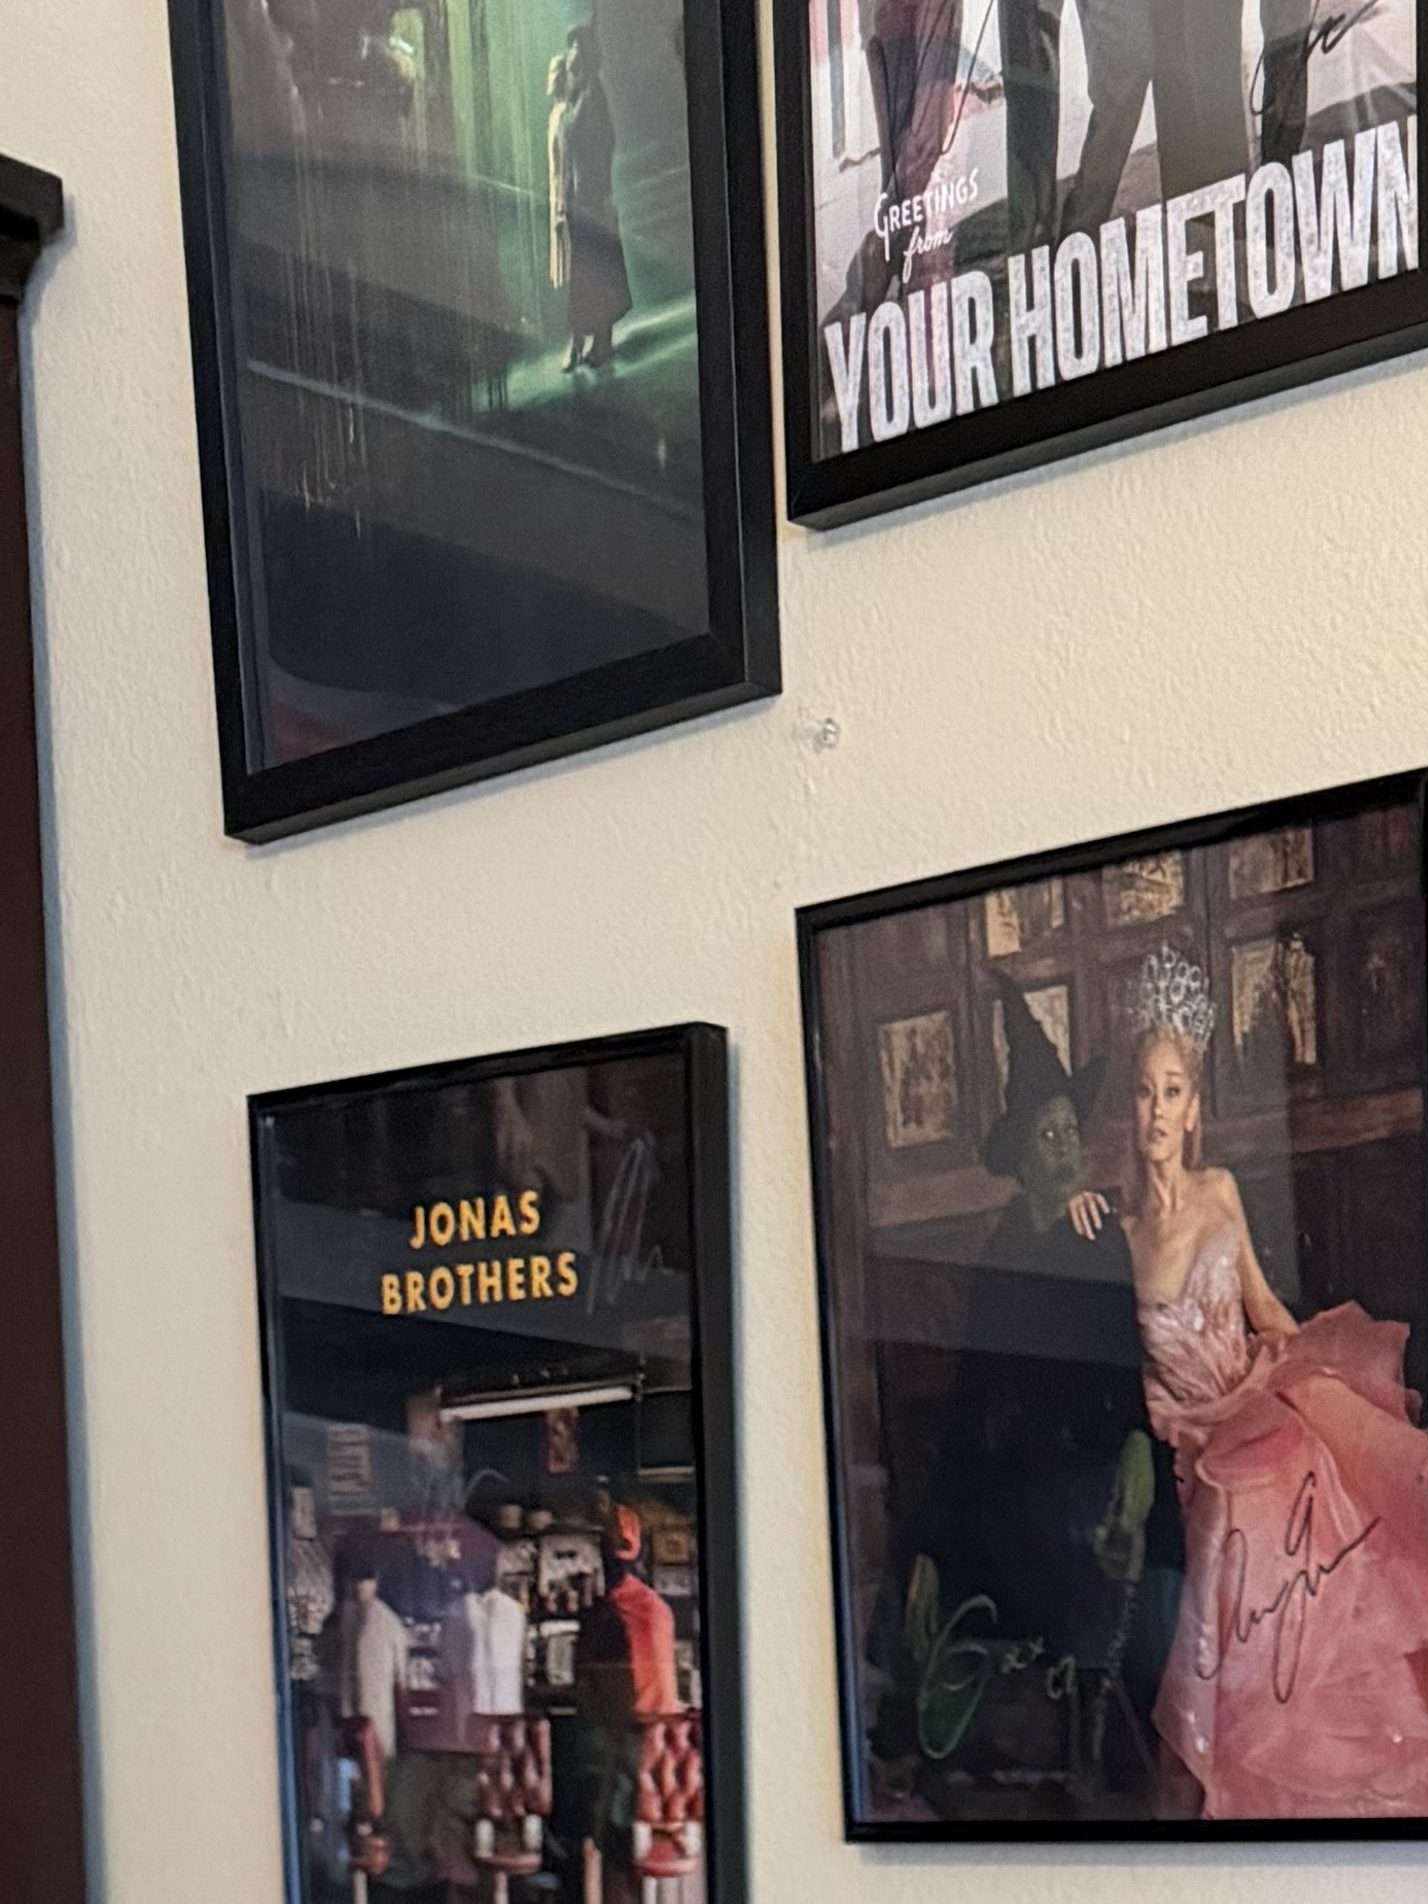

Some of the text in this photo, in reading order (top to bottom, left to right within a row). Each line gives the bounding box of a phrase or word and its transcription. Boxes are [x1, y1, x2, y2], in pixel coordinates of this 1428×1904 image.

[873, 167, 980, 263] GREETINGS
[824, 115, 1420, 453] YOUR HOMETOWN
[902, 227, 954, 284] from
[409, 1189, 540, 1249] JONAS
[381, 1251, 578, 1315] BROTHERS
